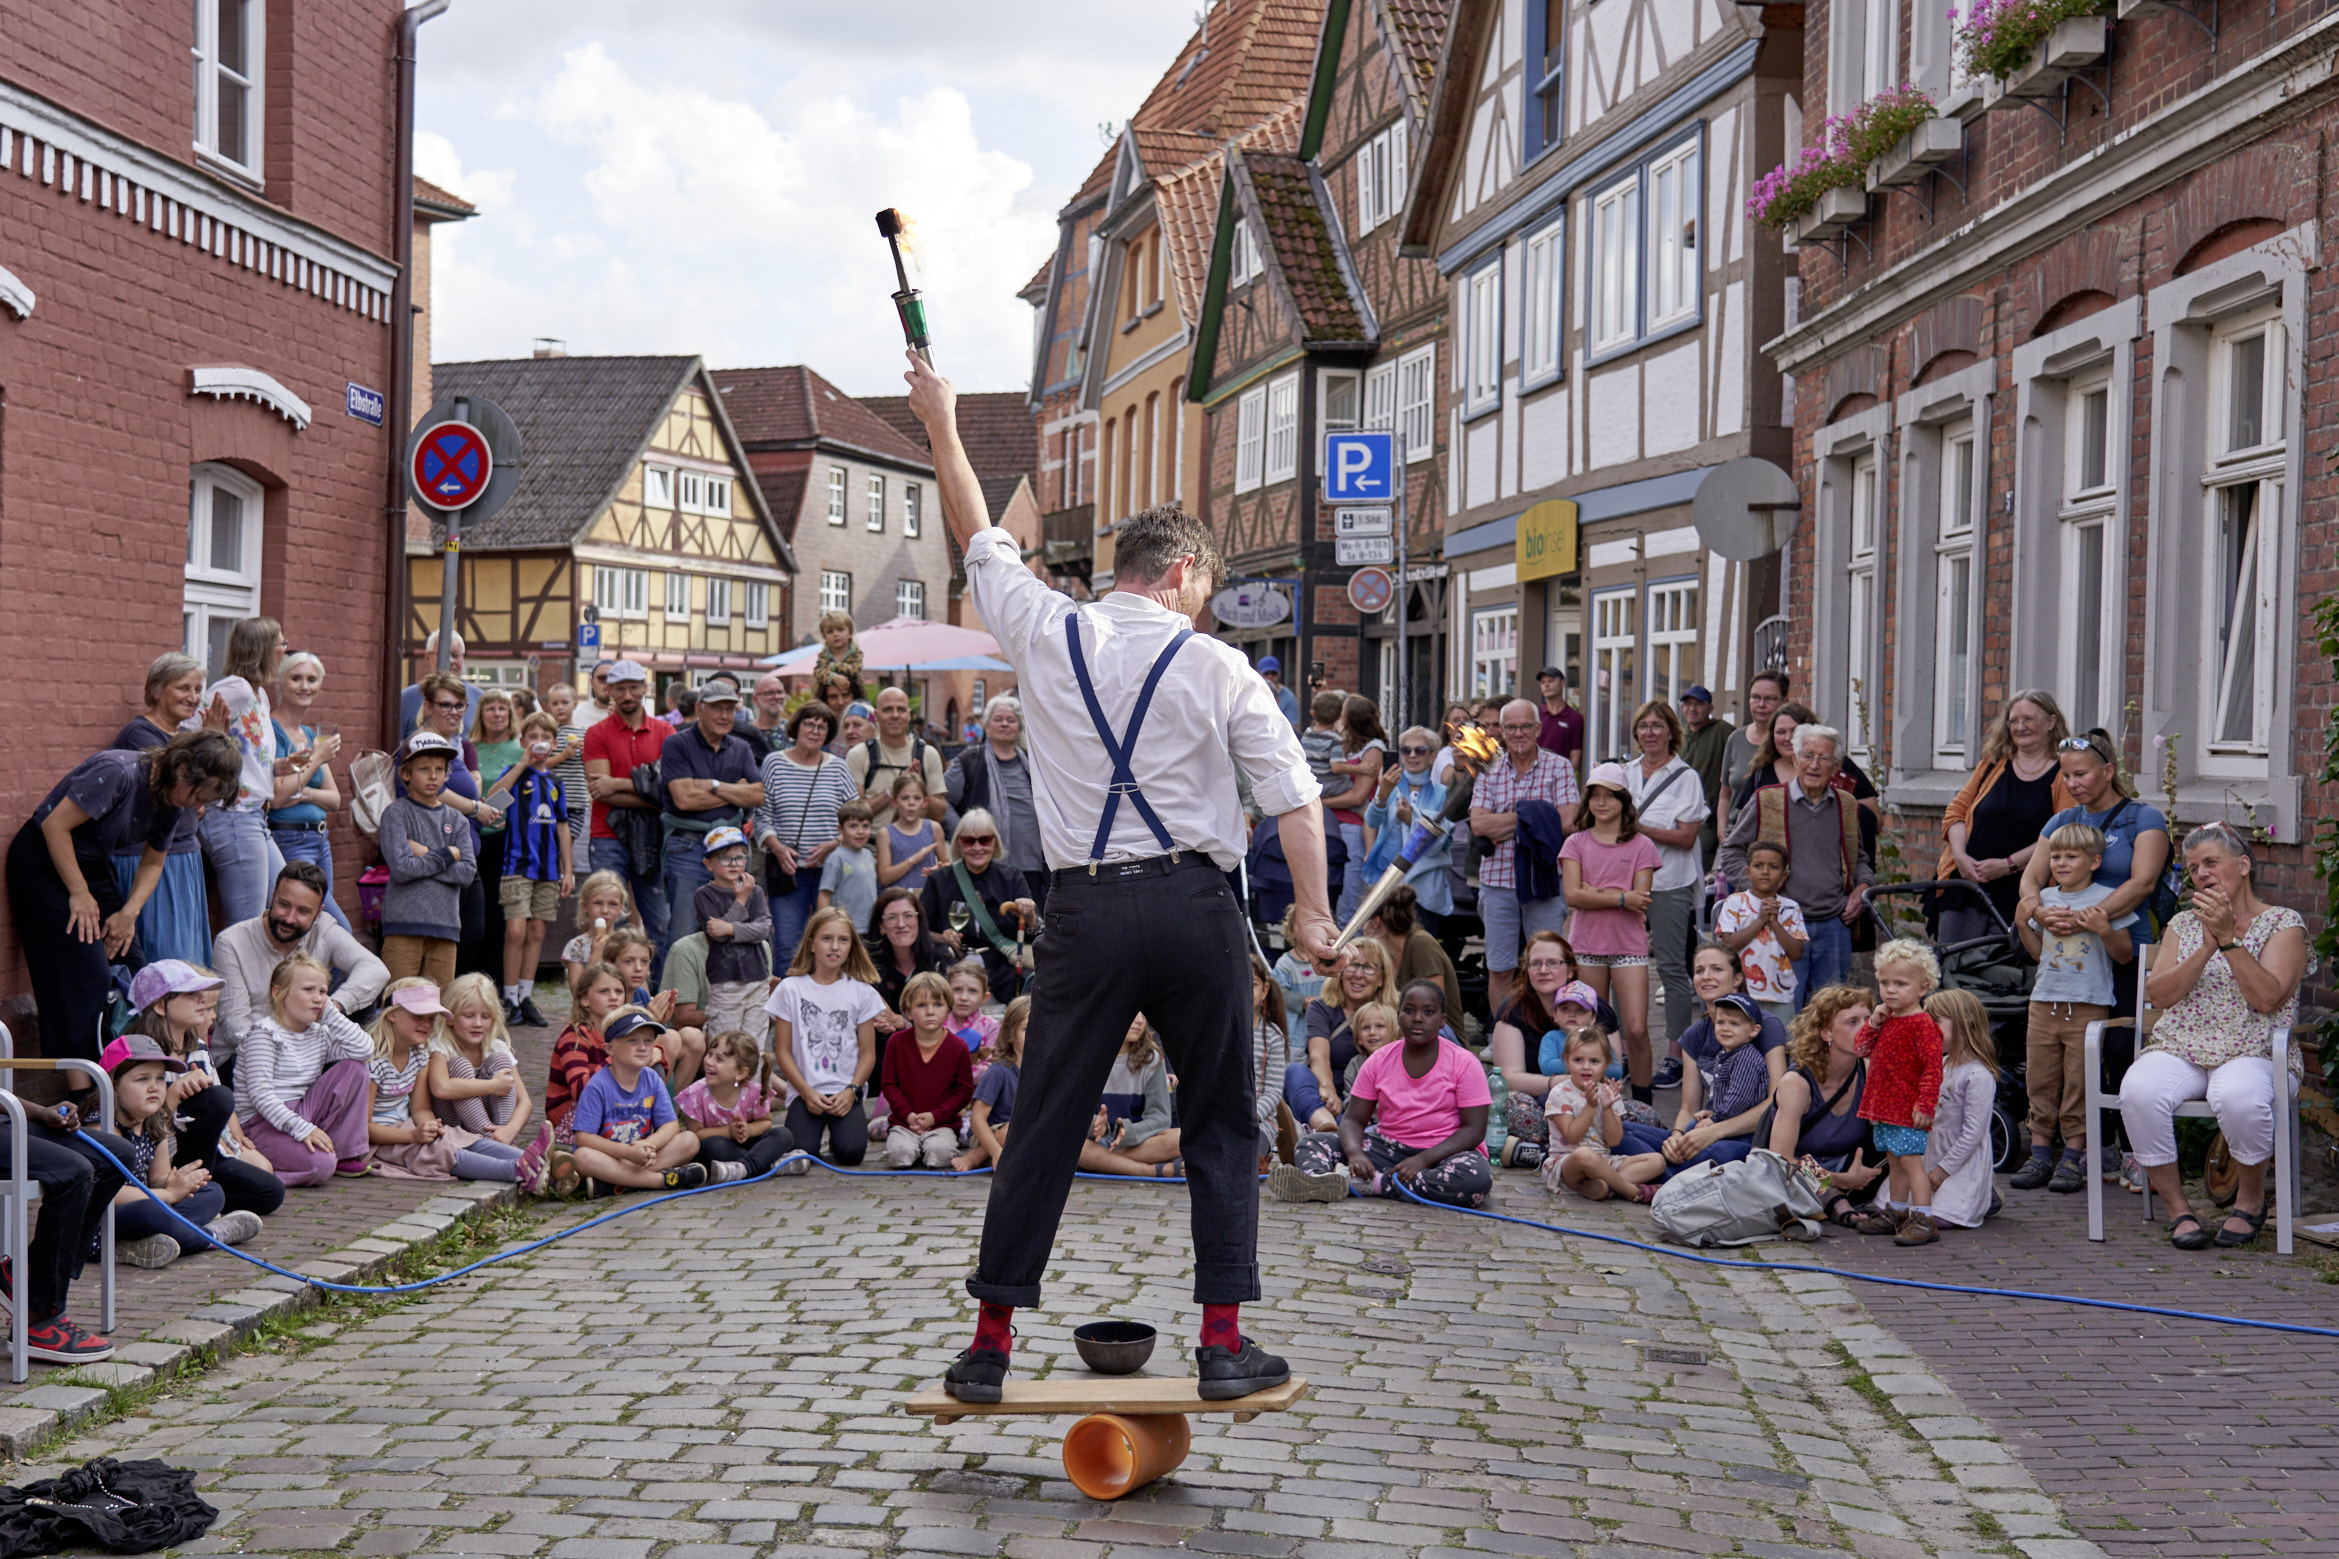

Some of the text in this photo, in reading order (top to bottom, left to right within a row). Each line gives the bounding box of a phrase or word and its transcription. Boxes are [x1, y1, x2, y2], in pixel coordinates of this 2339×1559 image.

[350, 387, 382, 418] Elbstraße
[1337, 442, 1372, 491] P
[1218, 602, 1282, 623] Buch und Musik
[583, 626, 595, 644] P
